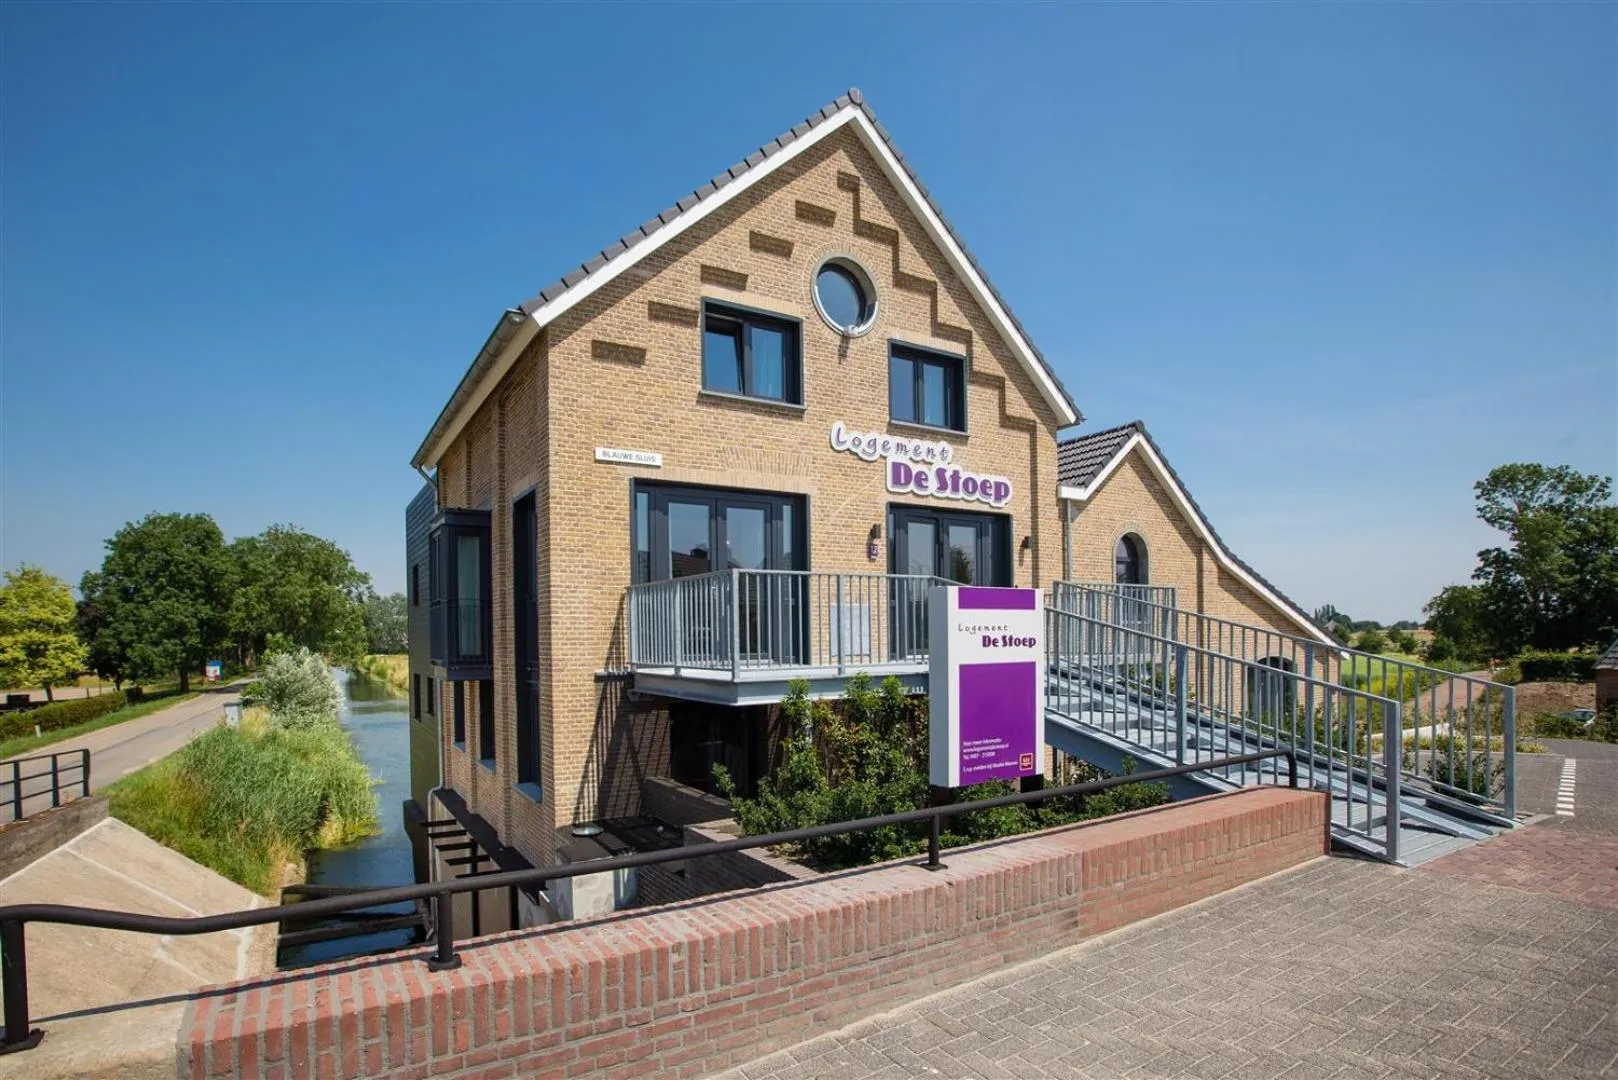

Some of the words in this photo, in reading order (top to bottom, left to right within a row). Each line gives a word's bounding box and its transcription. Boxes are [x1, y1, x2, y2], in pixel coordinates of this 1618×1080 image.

[836, 427, 949, 460] Logement
[602, 450, 633, 461] BLAUWE
[891, 461, 929, 490] De
[934, 467, 1011, 502] Stoep
[958, 623, 1009, 635] Logement
[982, 635, 999, 648] De
[1001, 635, 1037, 648] Stoep
